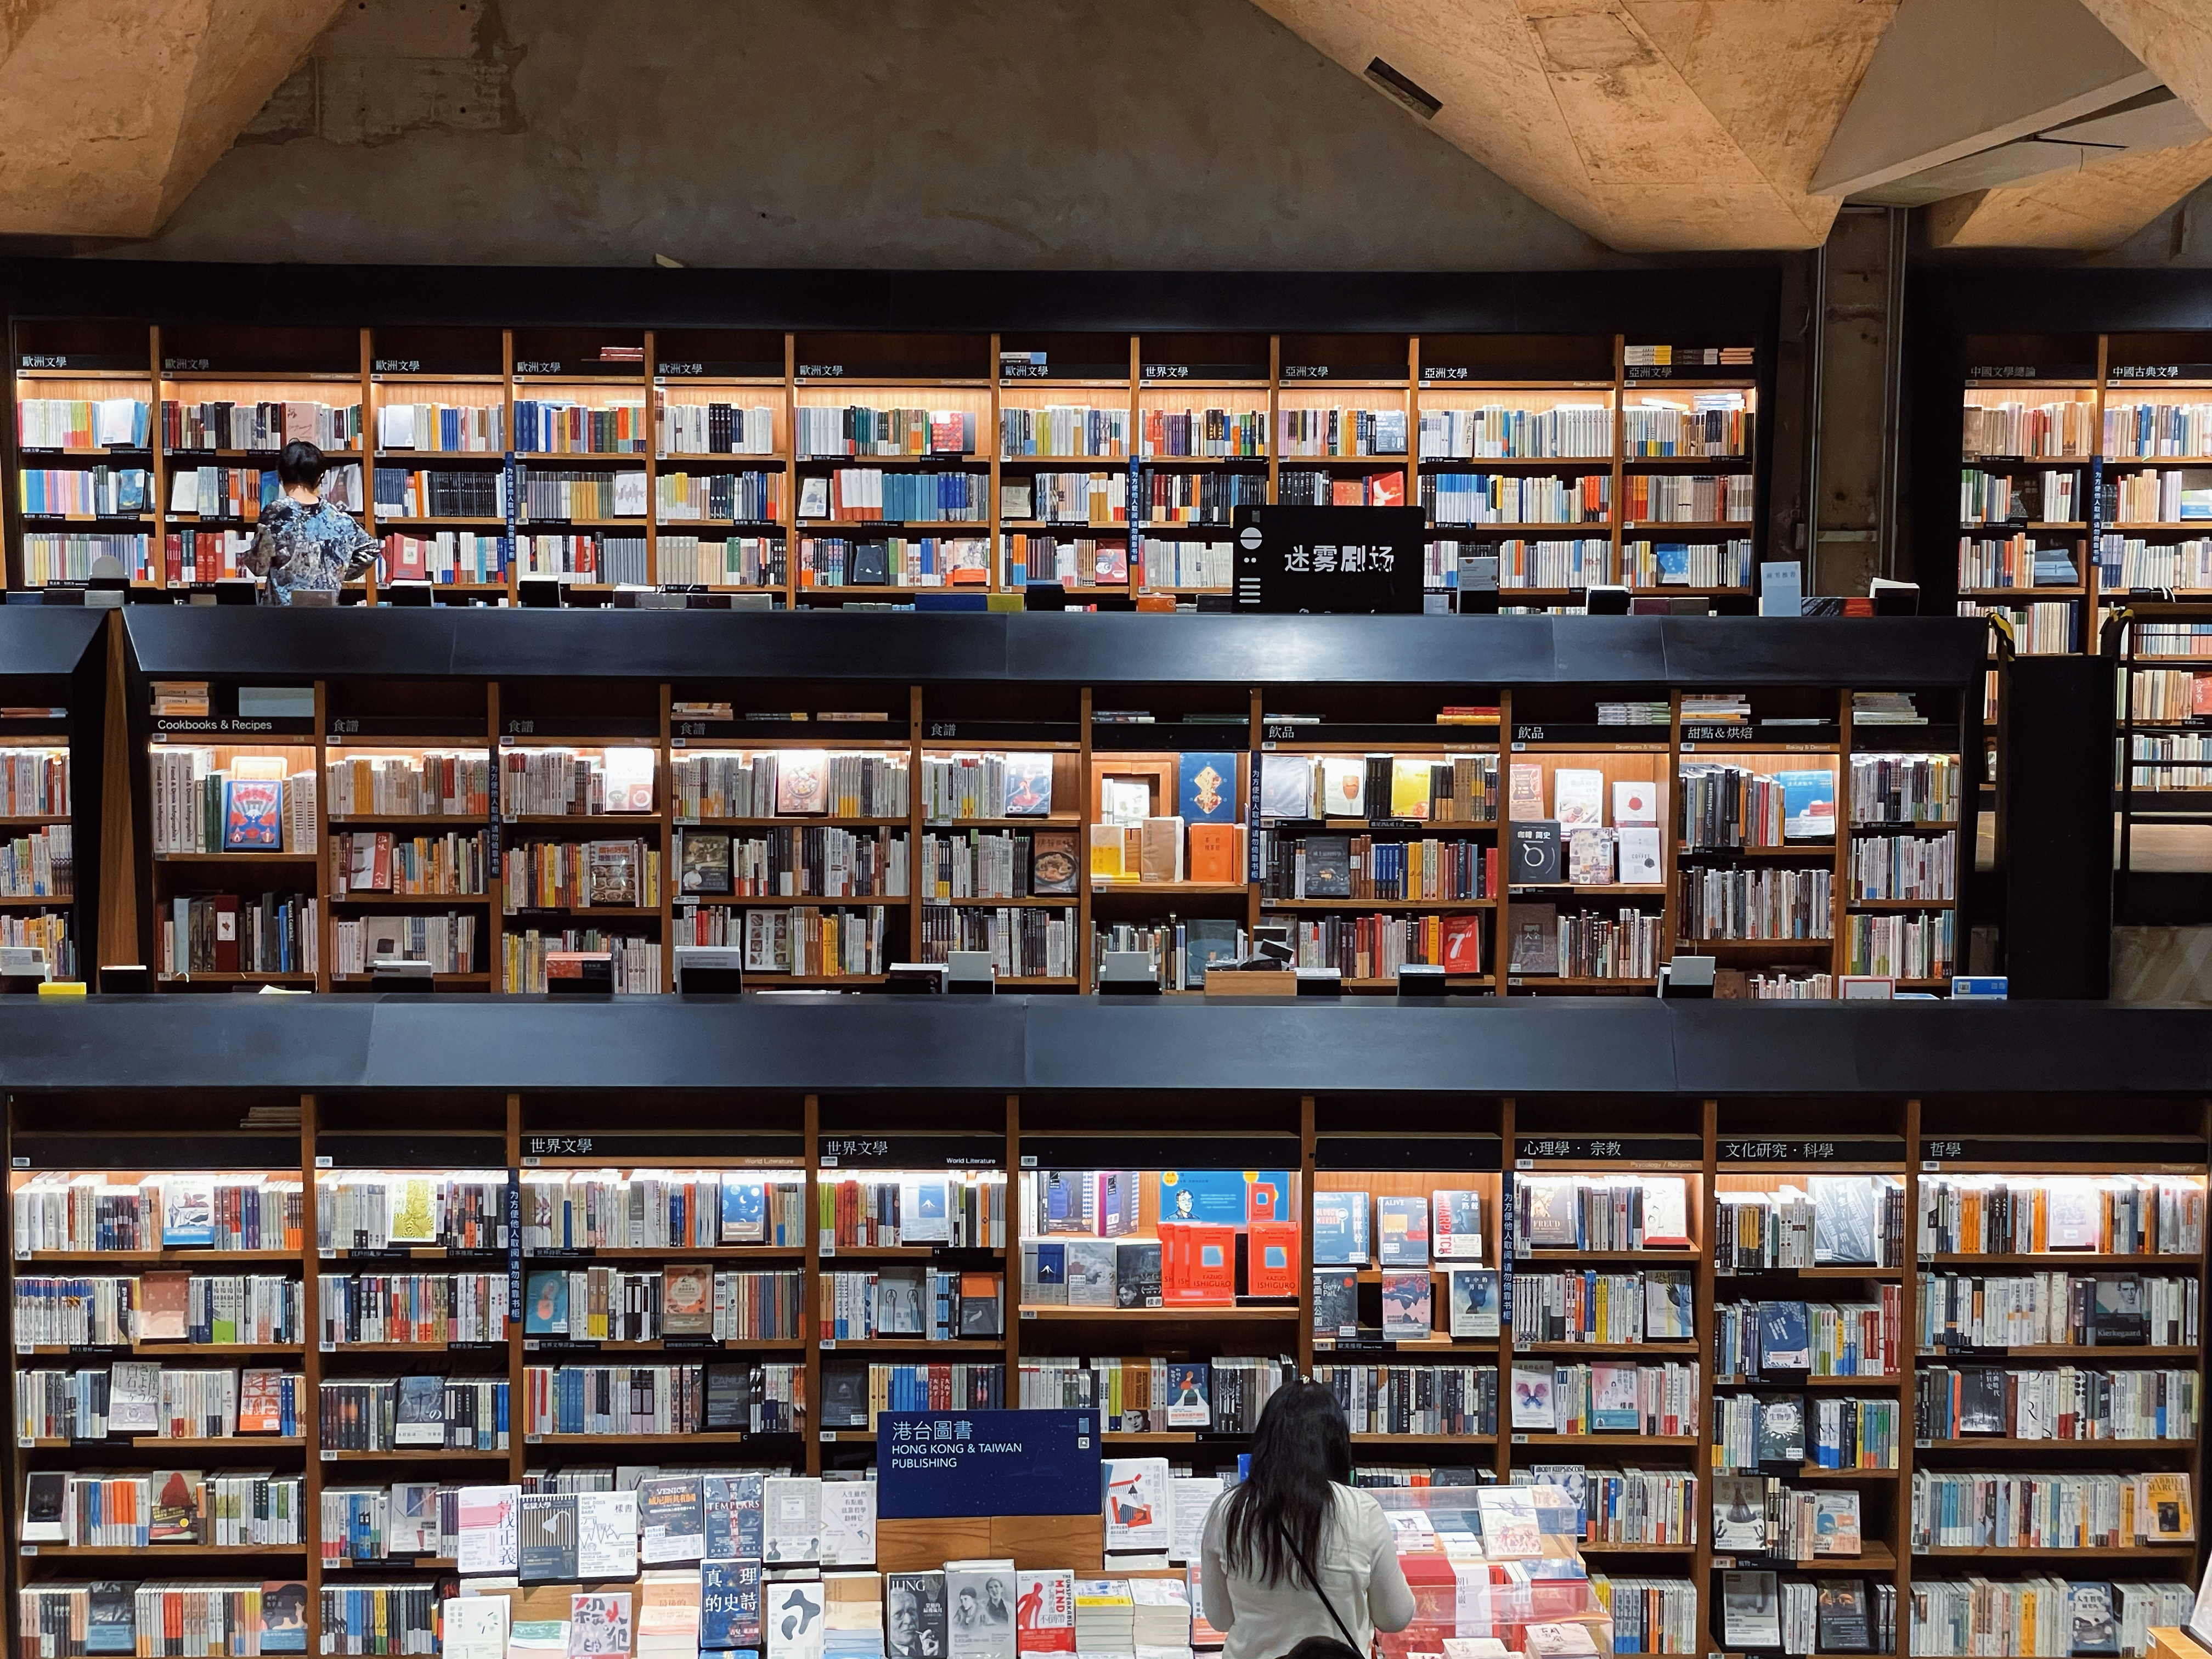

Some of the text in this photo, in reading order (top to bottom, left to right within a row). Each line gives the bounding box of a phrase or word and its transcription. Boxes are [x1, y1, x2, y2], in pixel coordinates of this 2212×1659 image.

[22, 356, 66, 368] 歐洲文學
[165, 359, 208, 370] 歐洲文學
[376, 360, 420, 371] 歐洲文學
[517, 362, 561, 373] 歐洲文學
[659, 363, 703, 375] 歐洲文學
[800, 365, 843, 376] 歐洲文學
[1005, 365, 1048, 377] 歐洲文學
[1146, 366, 1188, 377] 世界文學
[1285, 366, 1328, 377] 亞洲文學
[1425, 368, 1468, 379] 亞洲文學
[1629, 366, 1672, 377] 亞洲文學
[2113, 366, 2179, 377] 中國古典文學
[1284, 544, 1394, 572] 迷雾剧场
[158, 720, 272, 731] Cookbooks & Recipes
[333, 719, 359, 732] 食譜
[509, 720, 534, 733] 食譜
[680, 722, 706, 735] 食譜
[931, 723, 956, 736] 食譜
[1268, 726, 1295, 739] 飲品
[1518, 726, 1544, 740] 飲品
[1517, 831, 1533, 839] 咖啡
[530, 1138, 592, 1154] 世界文學
[826, 1140, 888, 1155] 世界文學
[1930, 1142, 1961, 1157] 哲學
[510, 1190, 520, 1318] 为方便他人取阅 请勿倚靠书柜
[1503, 1193, 1513, 1320] 为方便他人取阅 请勿倚靠书柜
[1193, 1280, 1232, 1288] ISHIGURO
[2097, 1329, 2141, 1338] Kierkegaard
[892, 1420, 973, 1441] 港台圖書
[892, 1442, 1022, 1455] HONG KONG & TAIWAN
[891, 1457, 957, 1469] PUBLISHING
[657, 1486, 687, 1495] VENICE
[615, 1504, 633, 1513] 樣書
[708, 1500, 760, 1511] TEMPLARS
[891, 1580, 926, 1592] JUNG
[705, 1592, 757, 1613] 的史詩
[1055, 1580, 1064, 1613] MIND
